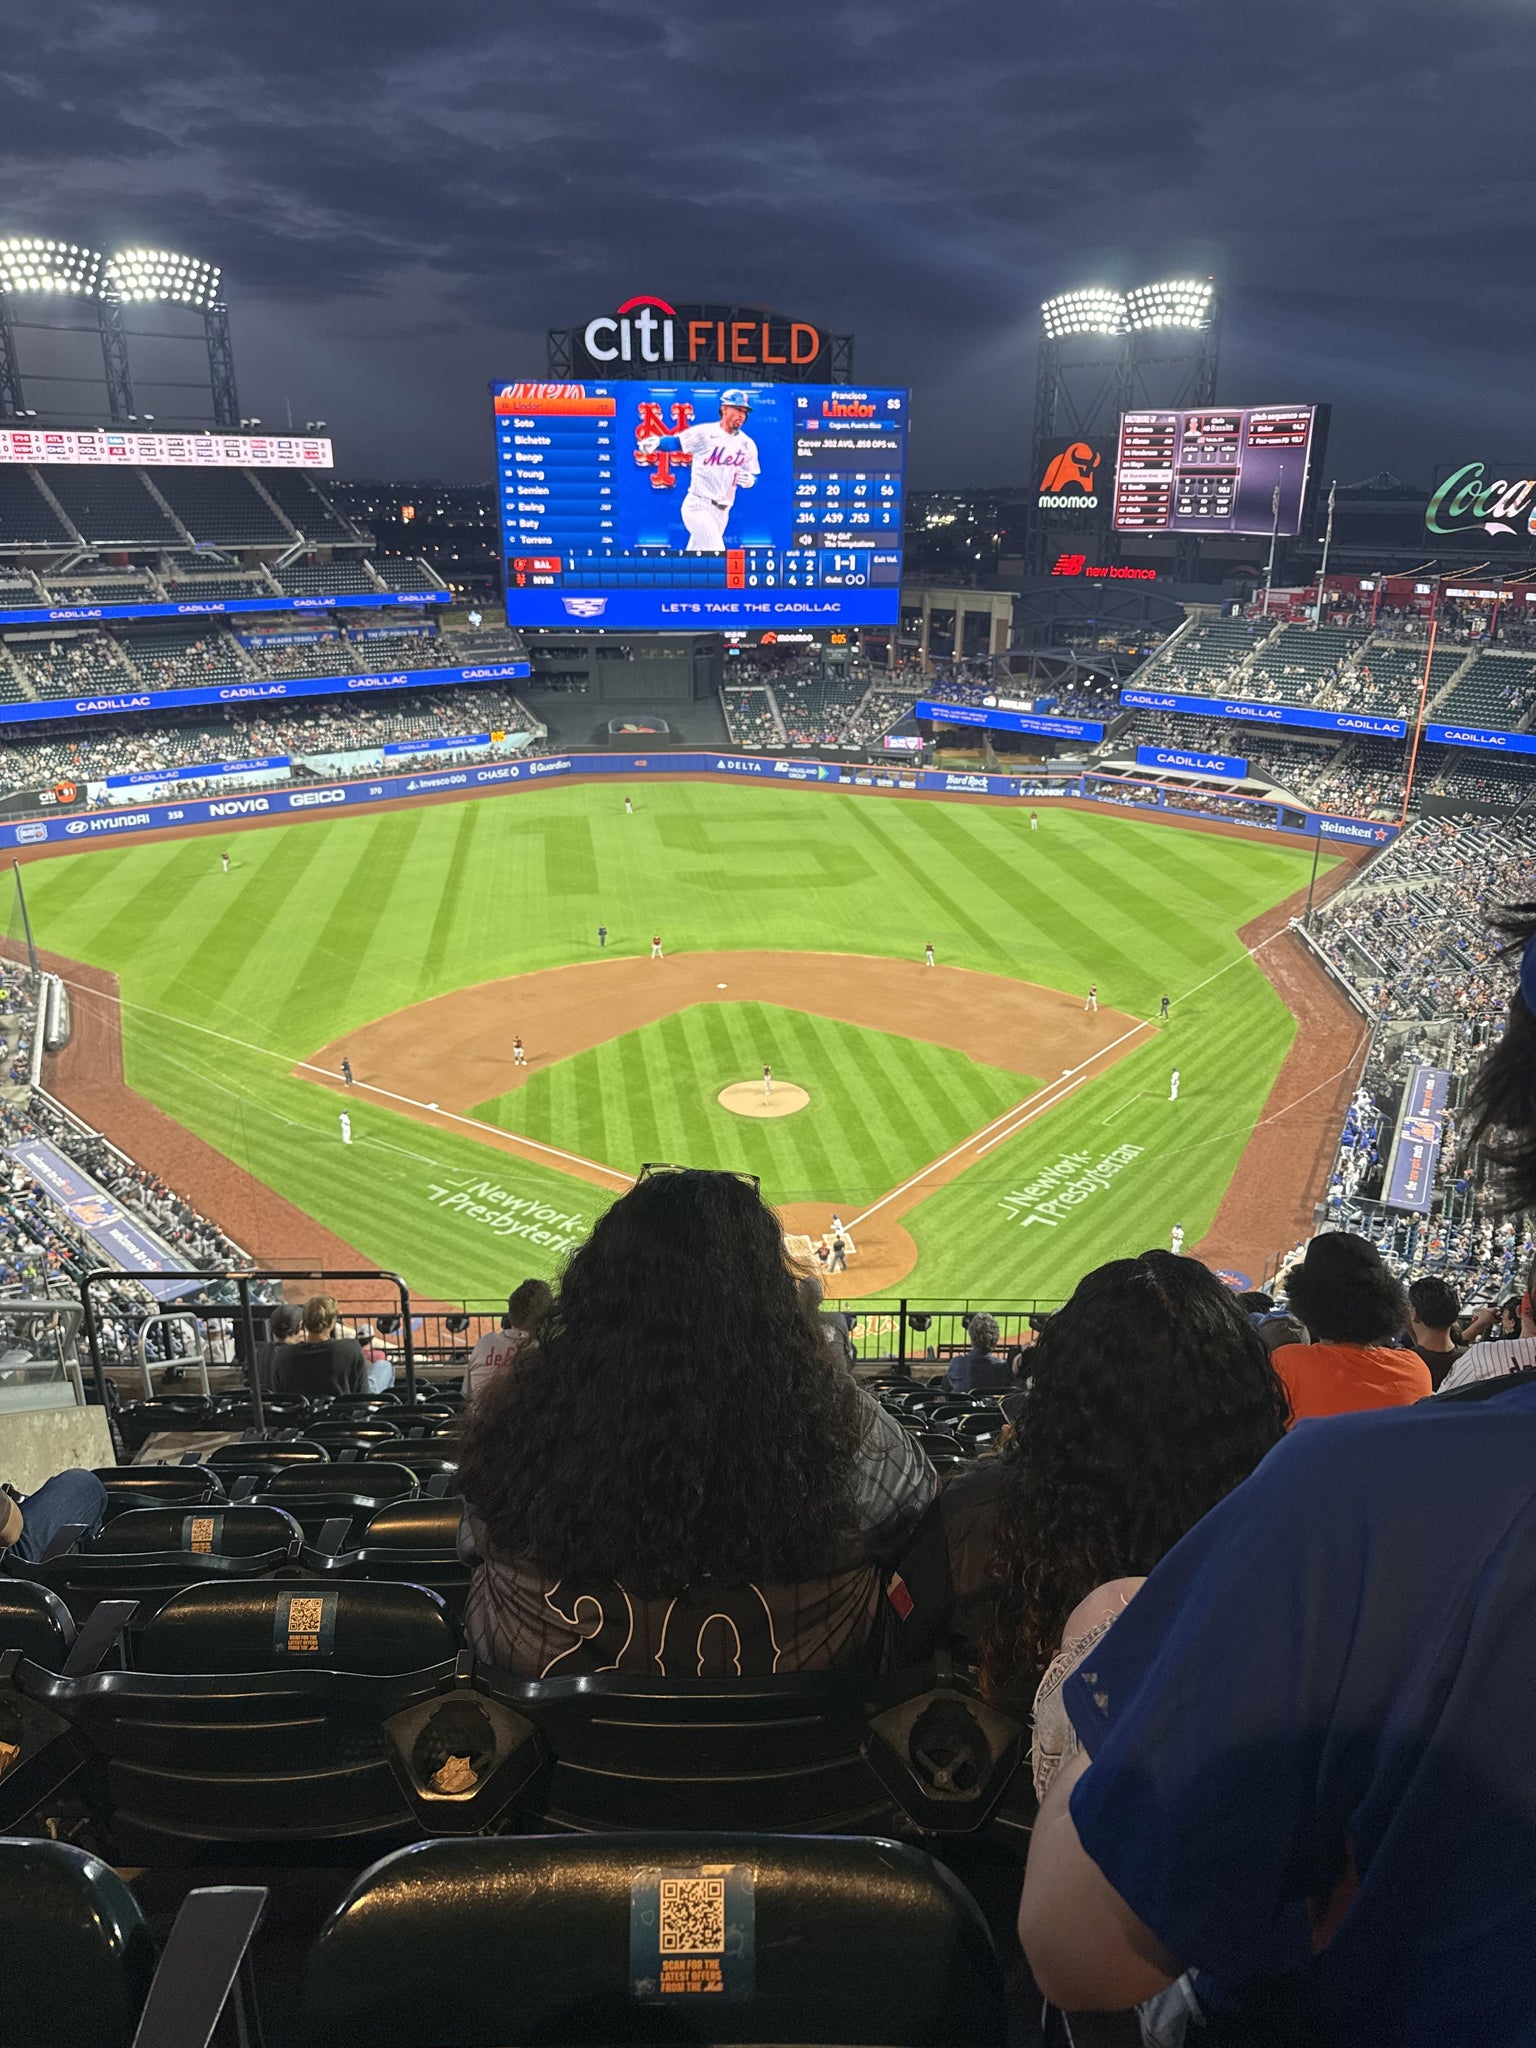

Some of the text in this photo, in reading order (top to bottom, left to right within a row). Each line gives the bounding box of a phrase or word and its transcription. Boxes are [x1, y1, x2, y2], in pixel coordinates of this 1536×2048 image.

[584, 307, 820, 364] citi FIELD
[831, 390, 867, 400] Francisco
[797, 397, 808, 408] 12
[822, 400, 876, 417] Lindor
[887, 398, 901, 409] SS
[514, 418, 535, 428] Soto
[1251, 413, 1267, 422] pitch
[514, 435, 551, 445] Bichette
[516, 469, 545, 481] Young
[796, 484, 894, 496] .229 20 47 56
[1038, 495, 1098, 509] moomoo
[1425, 462, 1532, 535] Coca
[518, 502, 545, 514] Ewing
[519, 518, 539, 530] Baty
[796, 512, 890, 524] .314 .439 .753 3
[520, 534, 553, 545] Torrens
[569, 558, 575, 570] 1
[750, 559, 756, 571] 1
[766, 559, 775, 571] 0
[788, 559, 797, 571] 4
[805, 559, 814, 571] 2
[833, 555, 856, 571] 1-1
[1085, 566, 1156, 580] new balance
[733, 576, 739, 585] 0
[749, 575, 758, 586] 0
[766, 575, 775, 586] 0
[788, 575, 797, 586] 4
[805, 575, 814, 586] 2
[293, 598, 336, 607] CADILLAC
[398, 594, 436, 602] CADILLAC
[50, 609, 102, 619] CADILLAC
[178, 603, 225, 613] CADILLAC
[661, 603, 841, 613] LET'S TAKE THE CADILLAC
[777, 633, 813, 642] moomoo
[462, 667, 515, 679] CADILLAC
[348, 675, 407, 688] CADILLAC
[220, 685, 287, 699] CADILLAC
[76, 696, 150, 712] CADILLAC
[1124, 694, 1176, 707] CADILLAC
[1225, 705, 1283, 719] CADILLAC
[1336, 717, 1400, 733] CADILLAC
[446, 737, 477, 746] CADILLAC
[1444, 730, 1507, 746] CADILLAC
[223, 760, 270, 772] CADILLAC
[537, 760, 572, 773] Guardian
[727, 761, 762, 771] DELTA
[1157, 753, 1225, 772] CADILLAC
[130, 771, 179, 783] CADILLAC
[477, 770, 509, 781] CHASE
[946, 774, 989, 787] Hard Rock
[420, 777, 450, 788] Invesco
[289, 789, 345, 807] GEICO
[209, 798, 269, 816] NOVIG
[167, 810, 184, 820] 358
[91, 813, 150, 831] HYUNDAI
[1233, 818, 1278, 831] CADILLAC
[1320, 820, 1371, 838] Heineken
[1409, 1169, 1419, 1181] new
[1035, 1144, 1145, 1219] Presbyterian
[1405, 1180, 1417, 1191] the
[110, 1228, 138, 1254] welcome
[662, 1959, 720, 1970] SCAN FOR THE
[661, 1970, 722, 1981] LATEST OFFERS
[661, 1982, 685, 1992] FROM
[687, 1982, 702, 1992] THE
